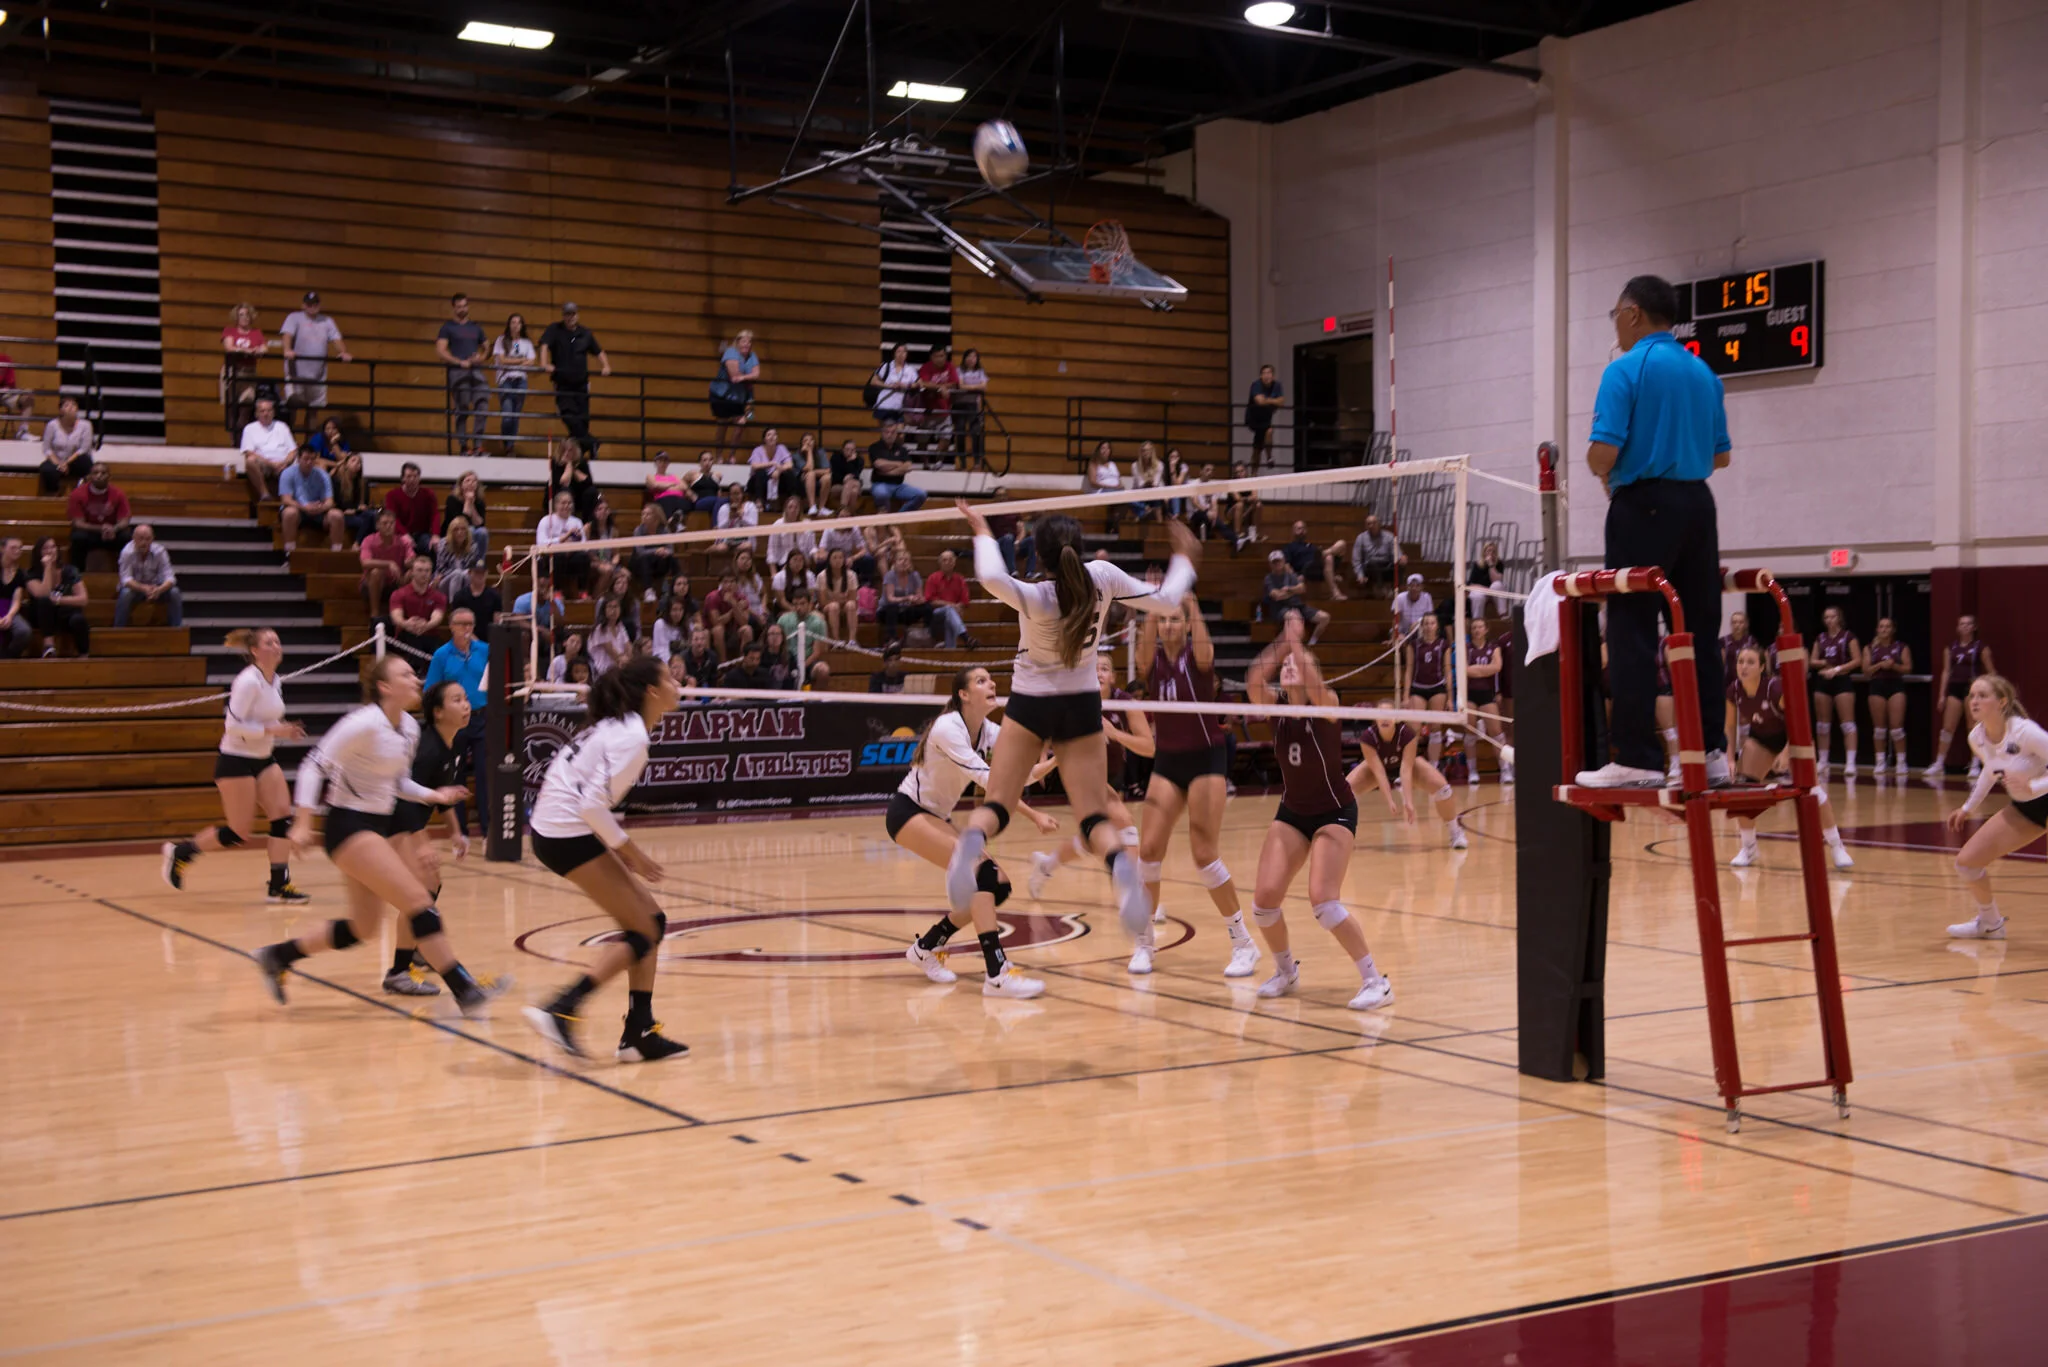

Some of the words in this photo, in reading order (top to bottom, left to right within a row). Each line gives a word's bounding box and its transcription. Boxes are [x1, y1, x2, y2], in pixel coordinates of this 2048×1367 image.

[1767, 305, 1808, 327] GUEST
[1725, 339, 1740, 362] 4
[1790, 325, 1809, 357] 9
[1288, 742, 1302, 766] 8
